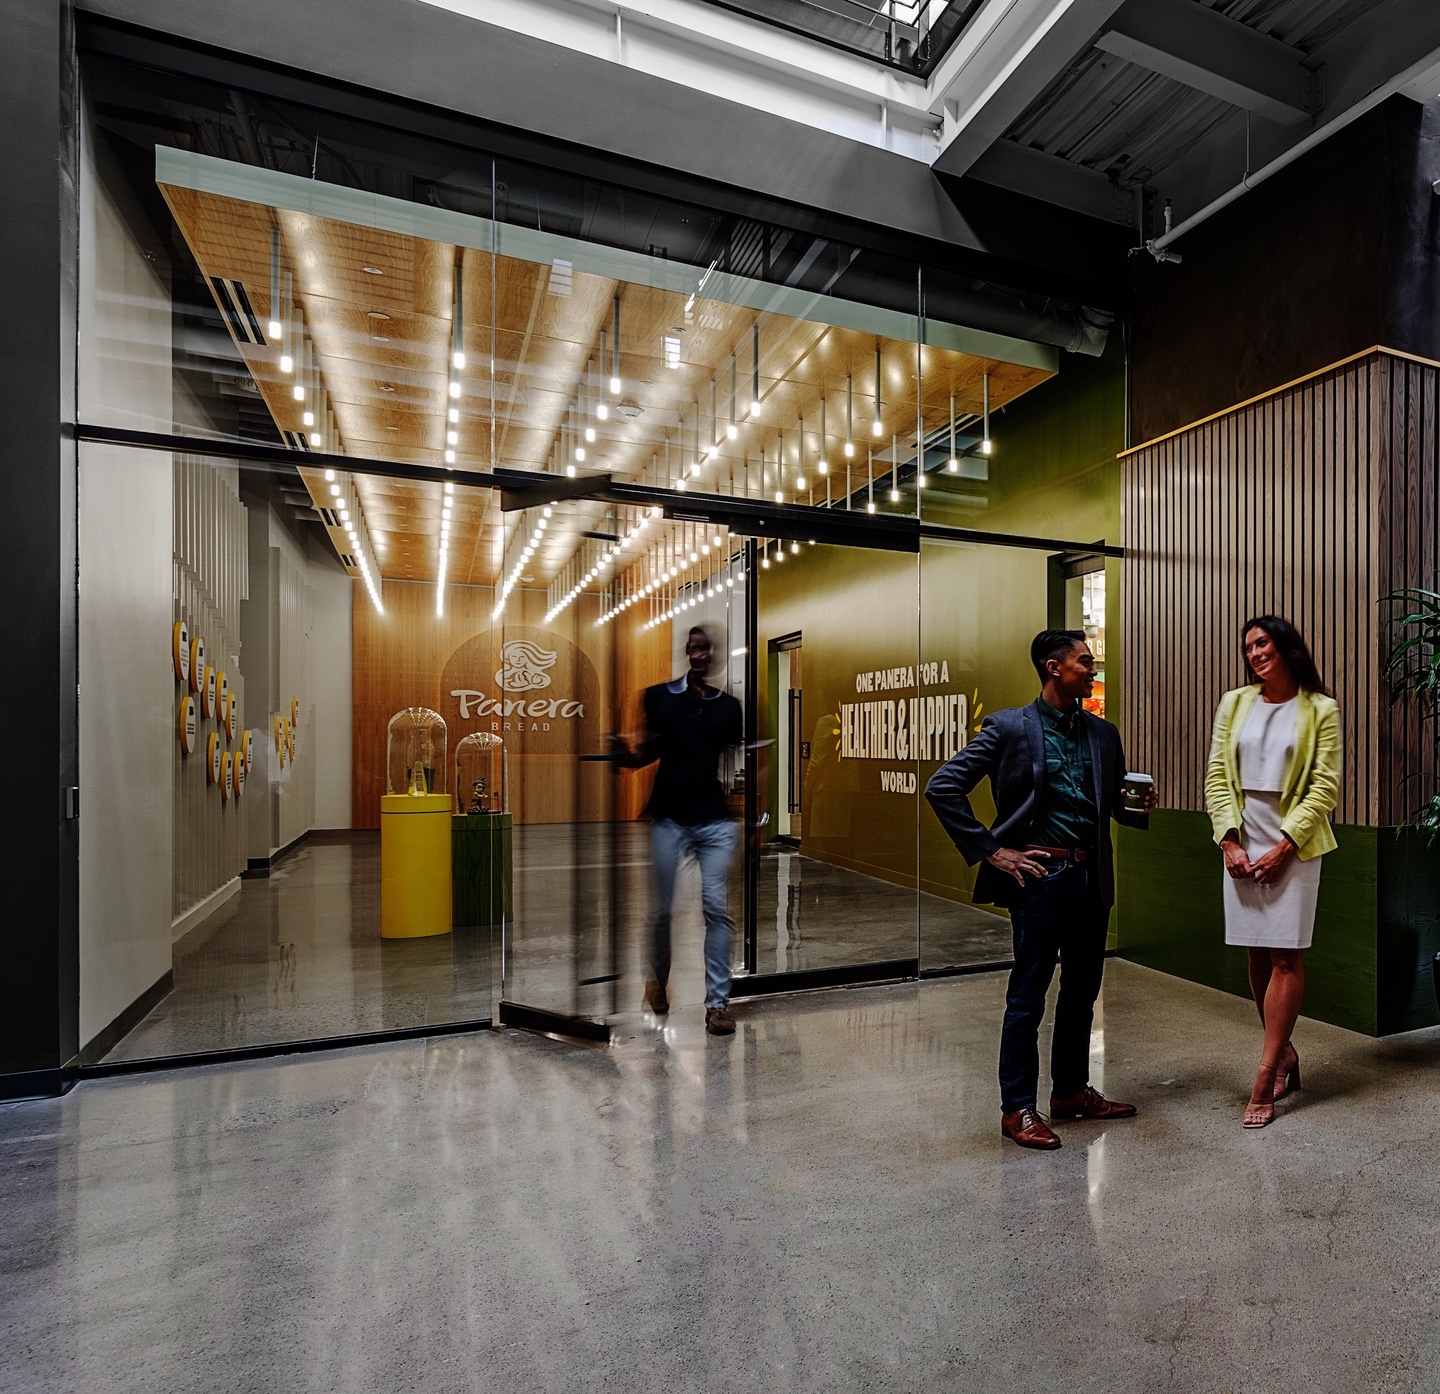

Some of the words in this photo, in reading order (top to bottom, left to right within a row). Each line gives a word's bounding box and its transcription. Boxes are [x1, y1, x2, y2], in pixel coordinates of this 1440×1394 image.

[856, 670, 874, 694] ONE
[874, 666, 914, 692] PANERA
[916, 662, 938, 686] FOR
[940, 660, 950, 684] A
[450, 690, 584, 720] Panera
[490, 722, 551, 732] BREAD
[841, 700, 896, 759] HEALTHIER
[896, 698, 910, 760] &
[909, 694, 969, 761] HAPPIER
[880, 770, 917, 795] WORLD
